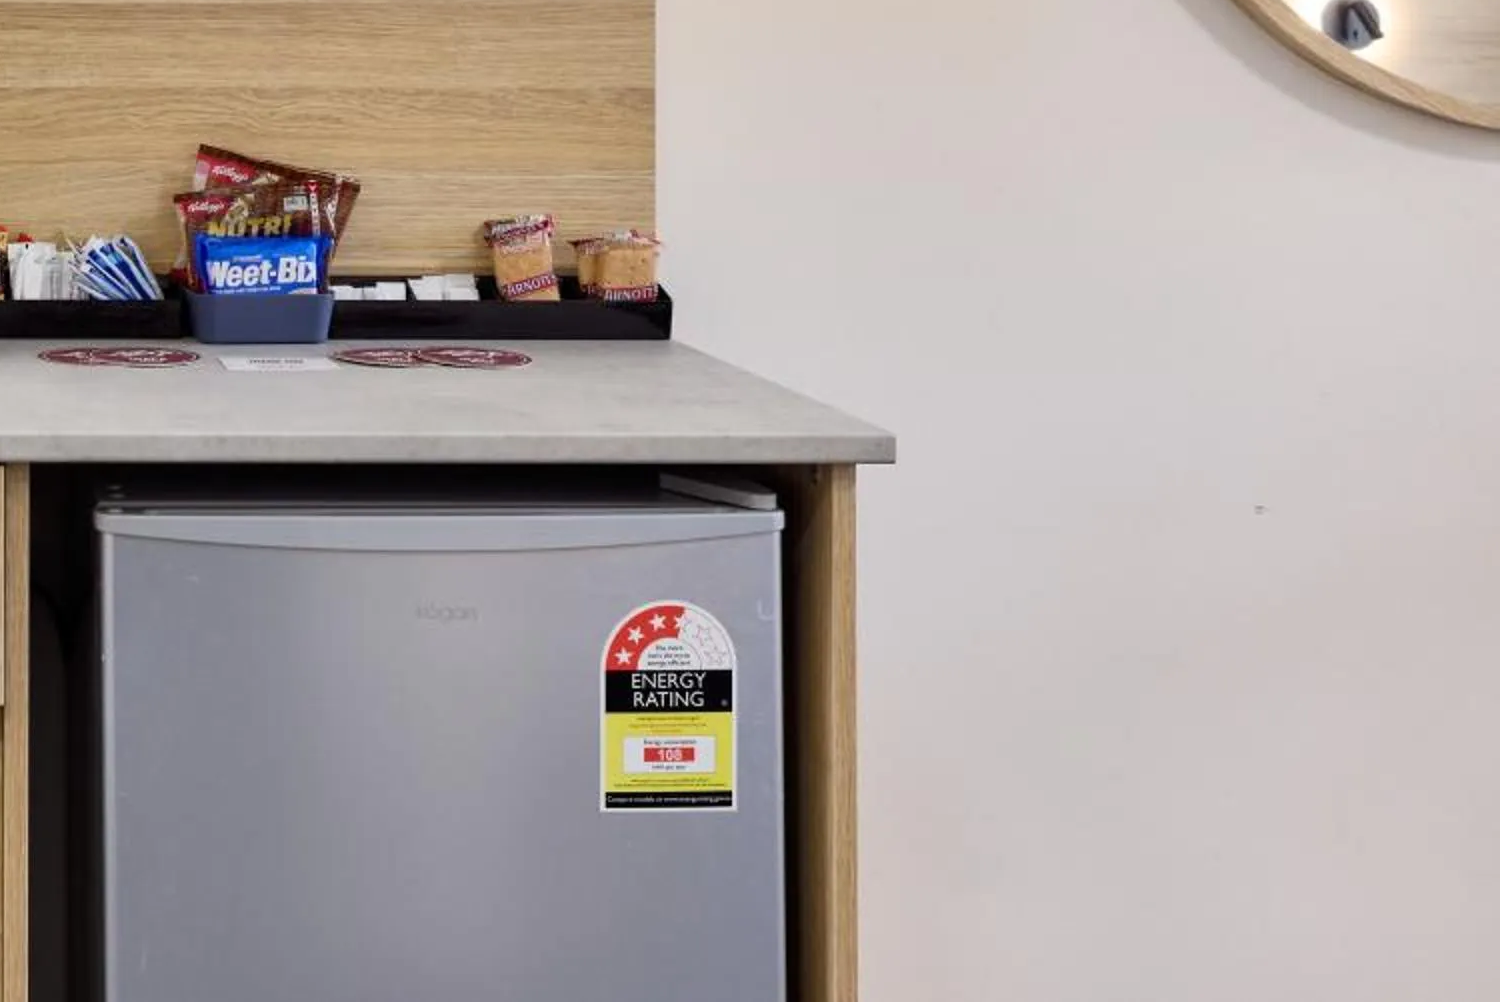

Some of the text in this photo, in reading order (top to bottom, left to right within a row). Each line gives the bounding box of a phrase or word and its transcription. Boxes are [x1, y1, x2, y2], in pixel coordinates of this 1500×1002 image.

[206, 255, 317, 288] Weet-Bix
[631, 672, 707, 689] ENERGY
[633, 691, 705, 708] RATING
